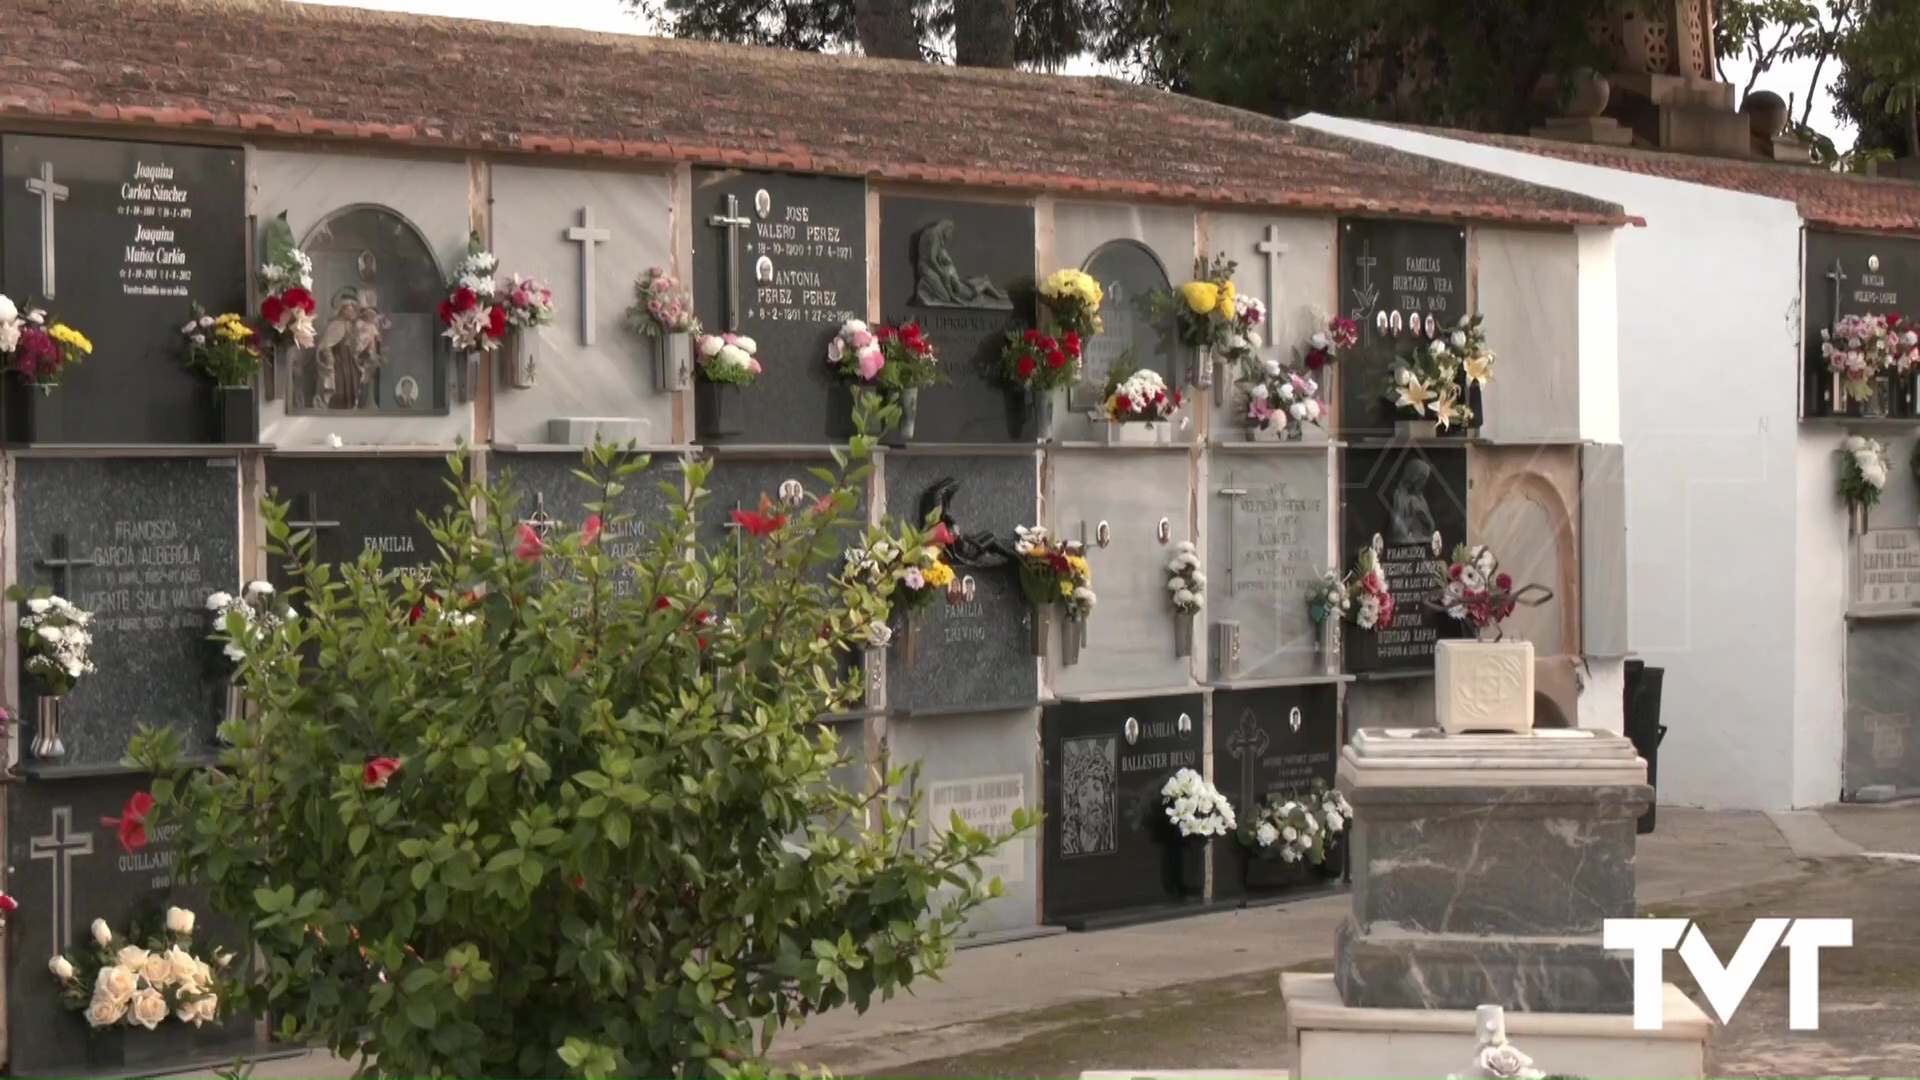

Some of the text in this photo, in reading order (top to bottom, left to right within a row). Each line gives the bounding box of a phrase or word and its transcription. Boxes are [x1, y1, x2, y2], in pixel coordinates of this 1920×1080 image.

[134, 161, 174, 182] Joaquina
[152, 184, 187, 202] Sánchez
[785, 206, 809, 222] JOSE
[134, 224, 175, 245] Joaquina
[756, 223, 841, 242] VALERO PEREZ
[124, 246, 155, 262] Muñoz
[1406, 256, 1441, 272] FAMILIAS
[775, 271, 820, 287] ANTONIA
[1392, 274, 1453, 294] HURTADO VERA
[757, 288, 837, 306] PEREZ PEREZ
[364, 536, 415, 552] FAMILIA
[944, 602, 983, 618] FAMILIA
